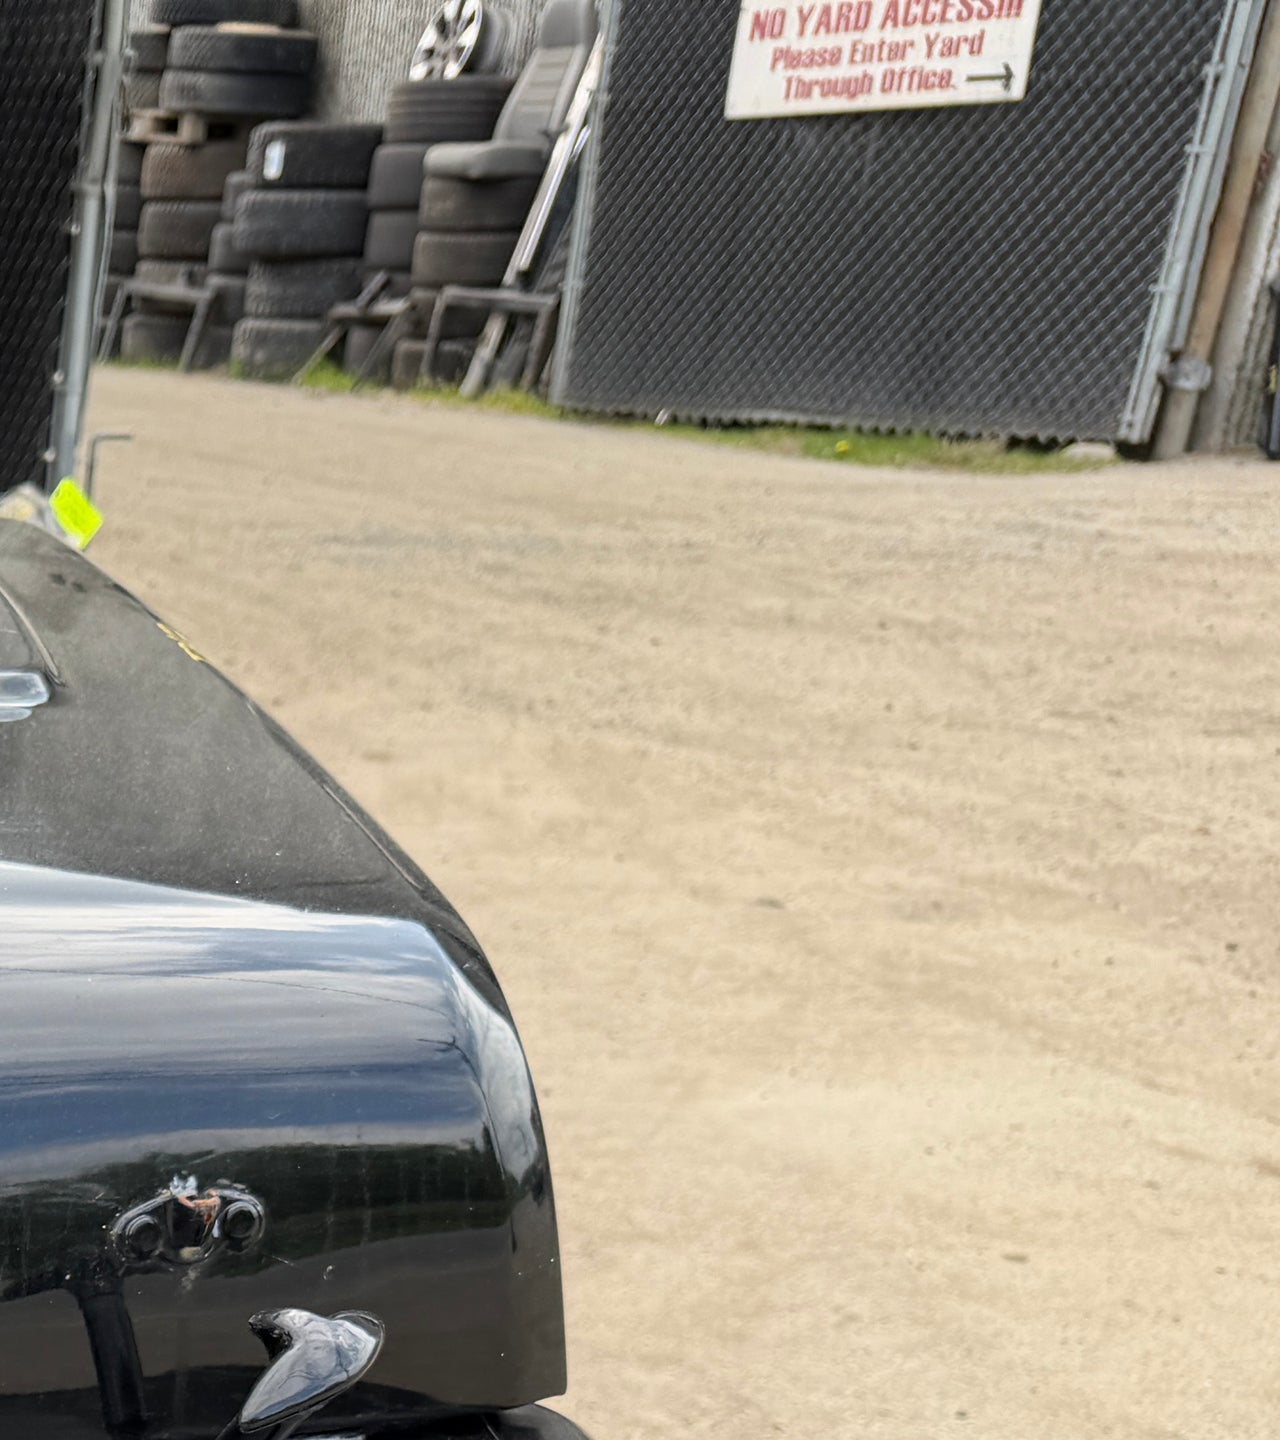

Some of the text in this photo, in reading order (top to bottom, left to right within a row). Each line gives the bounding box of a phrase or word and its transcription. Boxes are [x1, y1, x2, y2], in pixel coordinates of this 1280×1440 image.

[748, 8, 786, 41] NO
[797, 0, 874, 37] YARD
[770, 29, 986, 71] Please Enter Yard
[784, 69, 873, 102] Through
